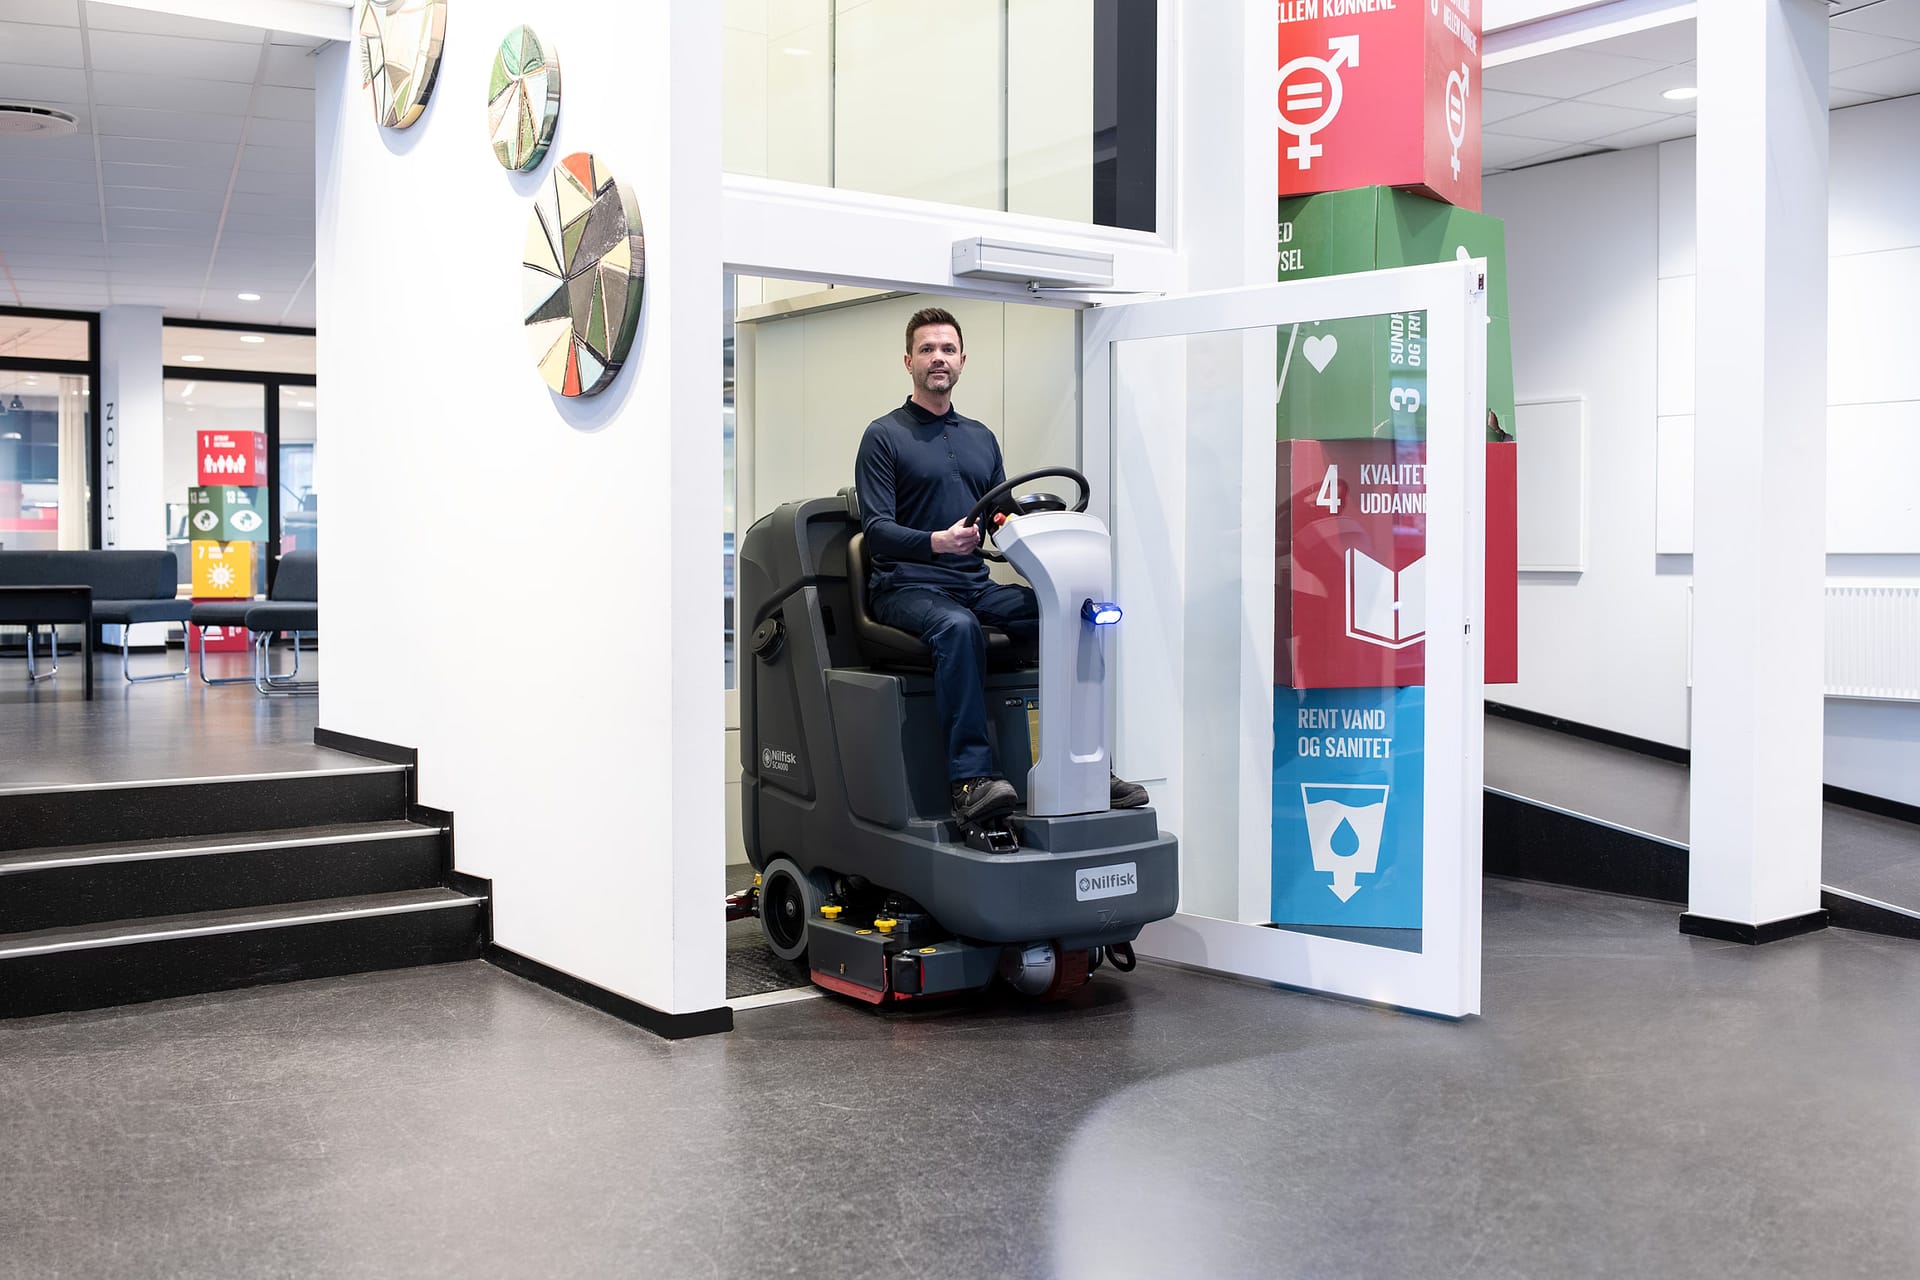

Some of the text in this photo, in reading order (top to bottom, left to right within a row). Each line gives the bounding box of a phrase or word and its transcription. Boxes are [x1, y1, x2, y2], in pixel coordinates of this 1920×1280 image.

[1278, 0, 1318, 23] LLEM
[1408, 311, 1421, 367] OG TRI
[1390, 386, 1420, 413] 3
[106, 402, 115, 546] EPTION
[1316, 464, 1342, 514] 4
[1298, 708, 1386, 730] RENT VAND
[771, 749, 796, 764] Nilfisk
[1298, 736, 1392, 759] OG SANITET
[1091, 872, 1135, 890] Nilfisk
